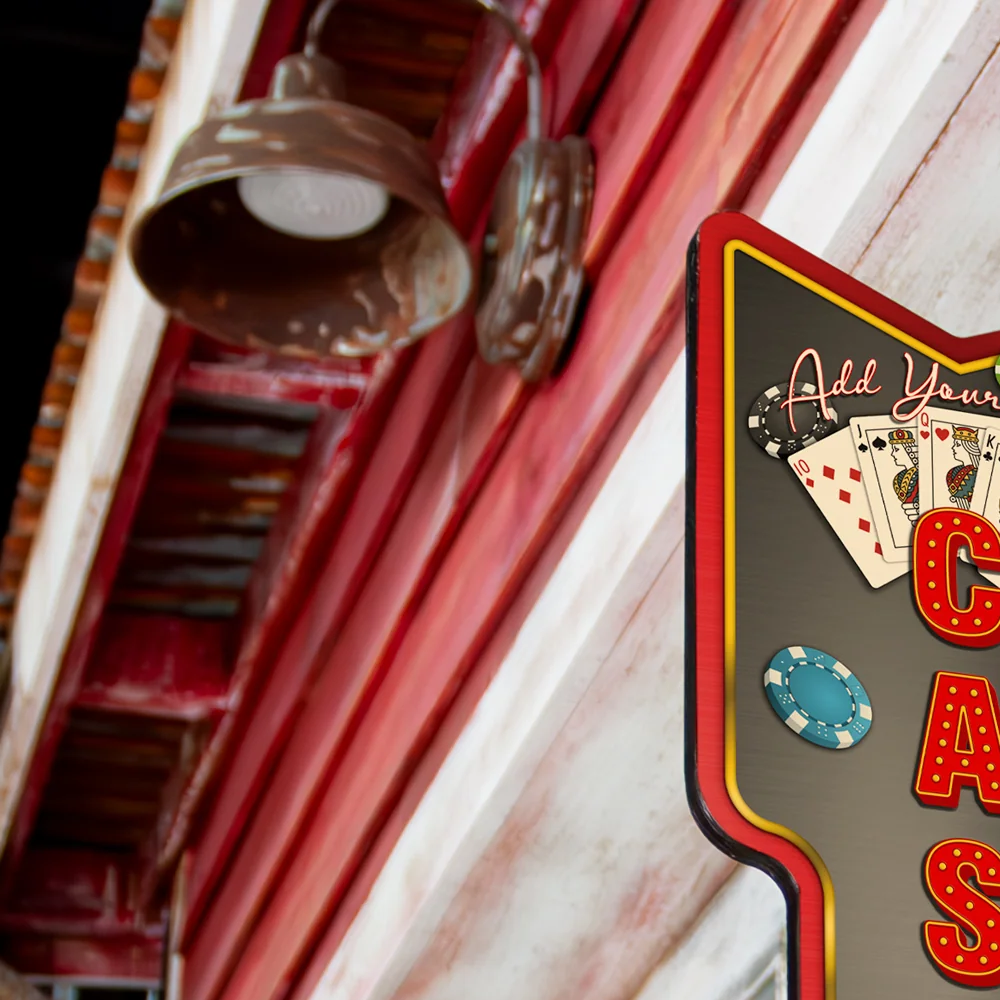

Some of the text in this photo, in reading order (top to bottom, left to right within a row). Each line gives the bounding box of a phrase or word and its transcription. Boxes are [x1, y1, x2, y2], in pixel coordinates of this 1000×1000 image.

[780, 347, 882, 434] Add
[920, 412, 929, 428] Q
[985, 433, 995, 449] K
[793, 458, 811, 477] 10
